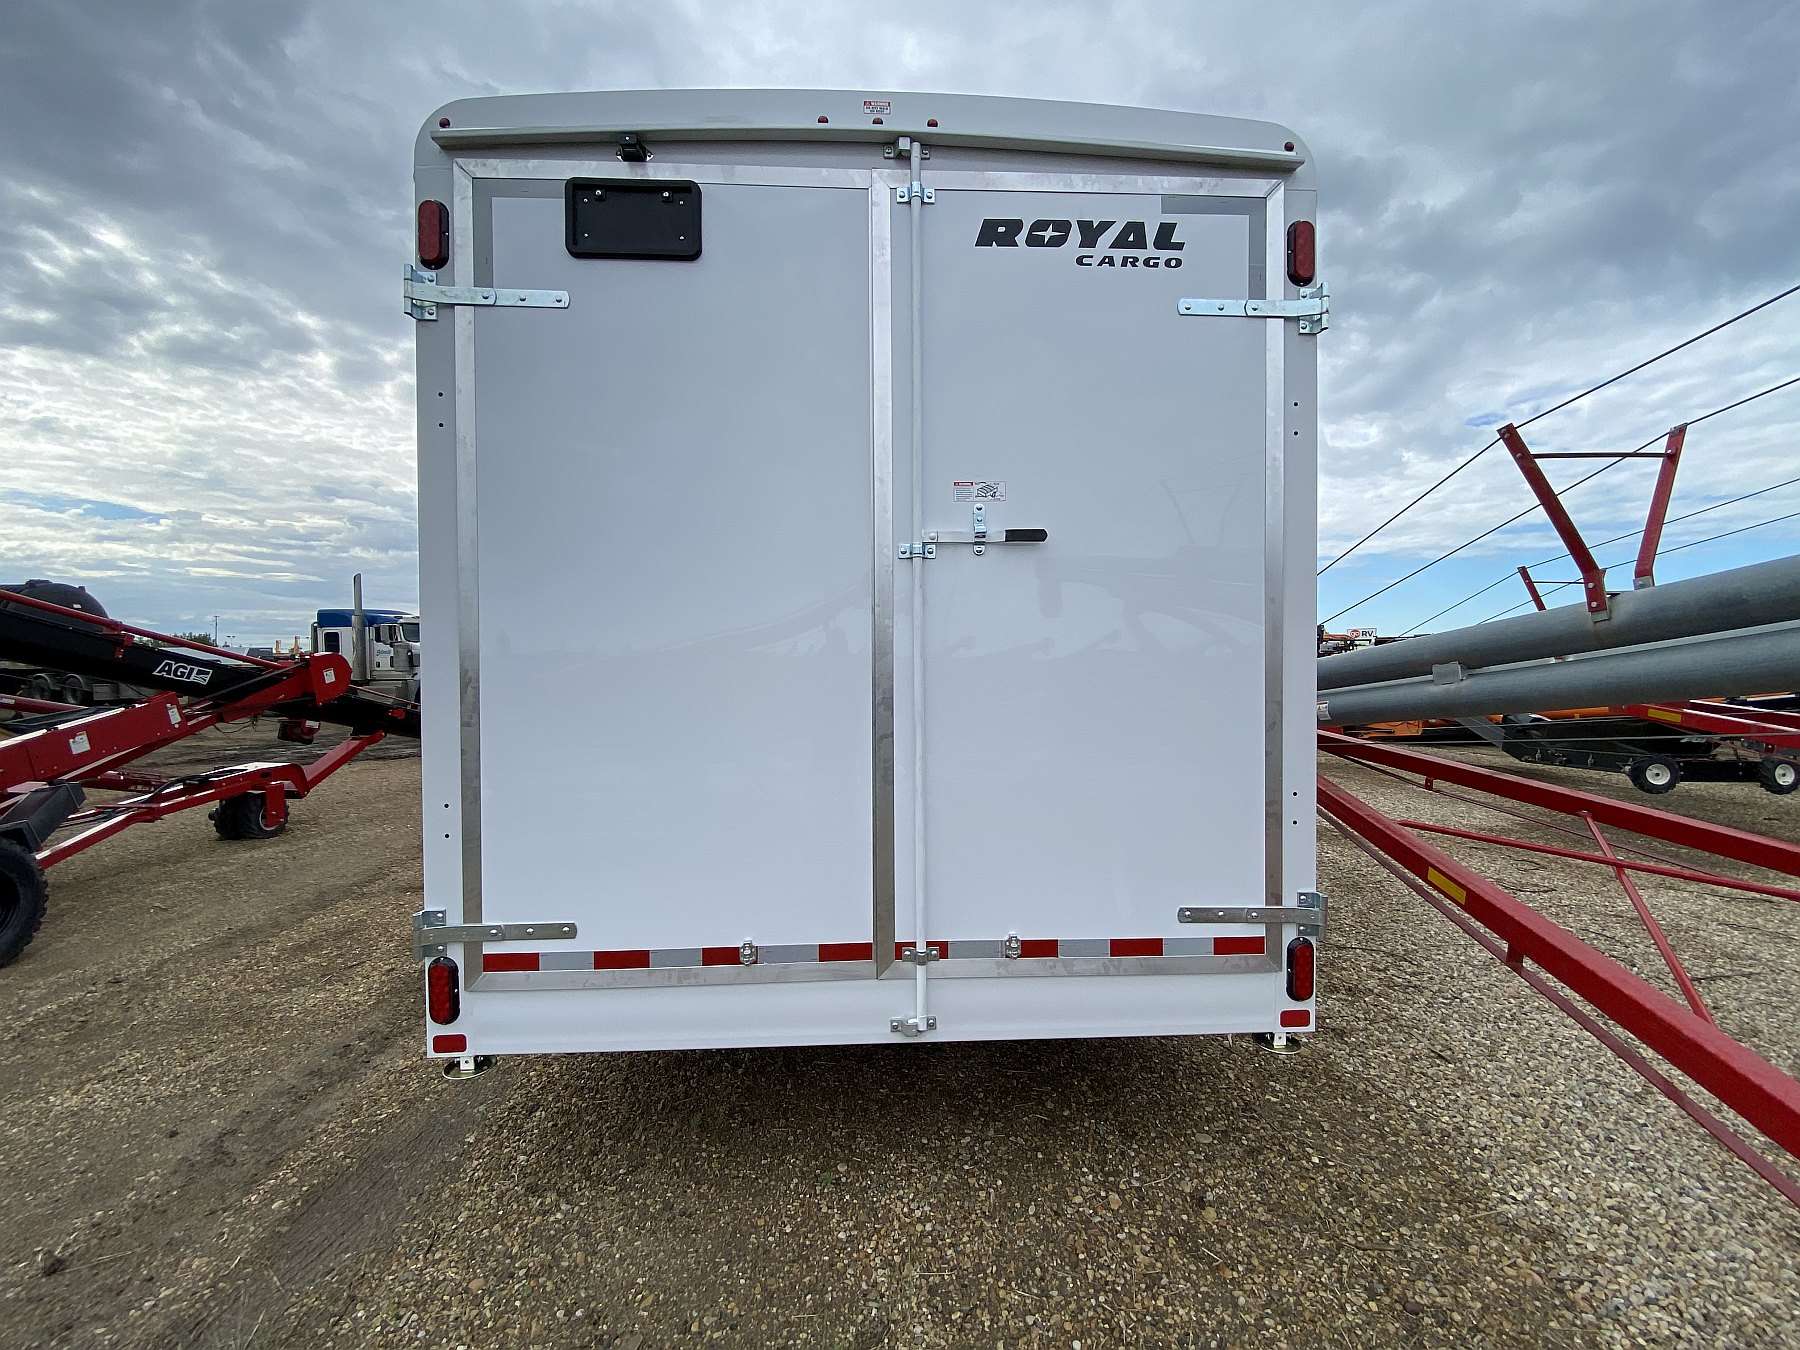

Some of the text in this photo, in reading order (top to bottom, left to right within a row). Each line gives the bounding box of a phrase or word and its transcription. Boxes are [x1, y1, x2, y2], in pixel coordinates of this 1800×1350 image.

[974, 218, 1186, 251] ROYAL
[1075, 254, 1183, 269] CARGO
[152, 660, 197, 682] AGI
